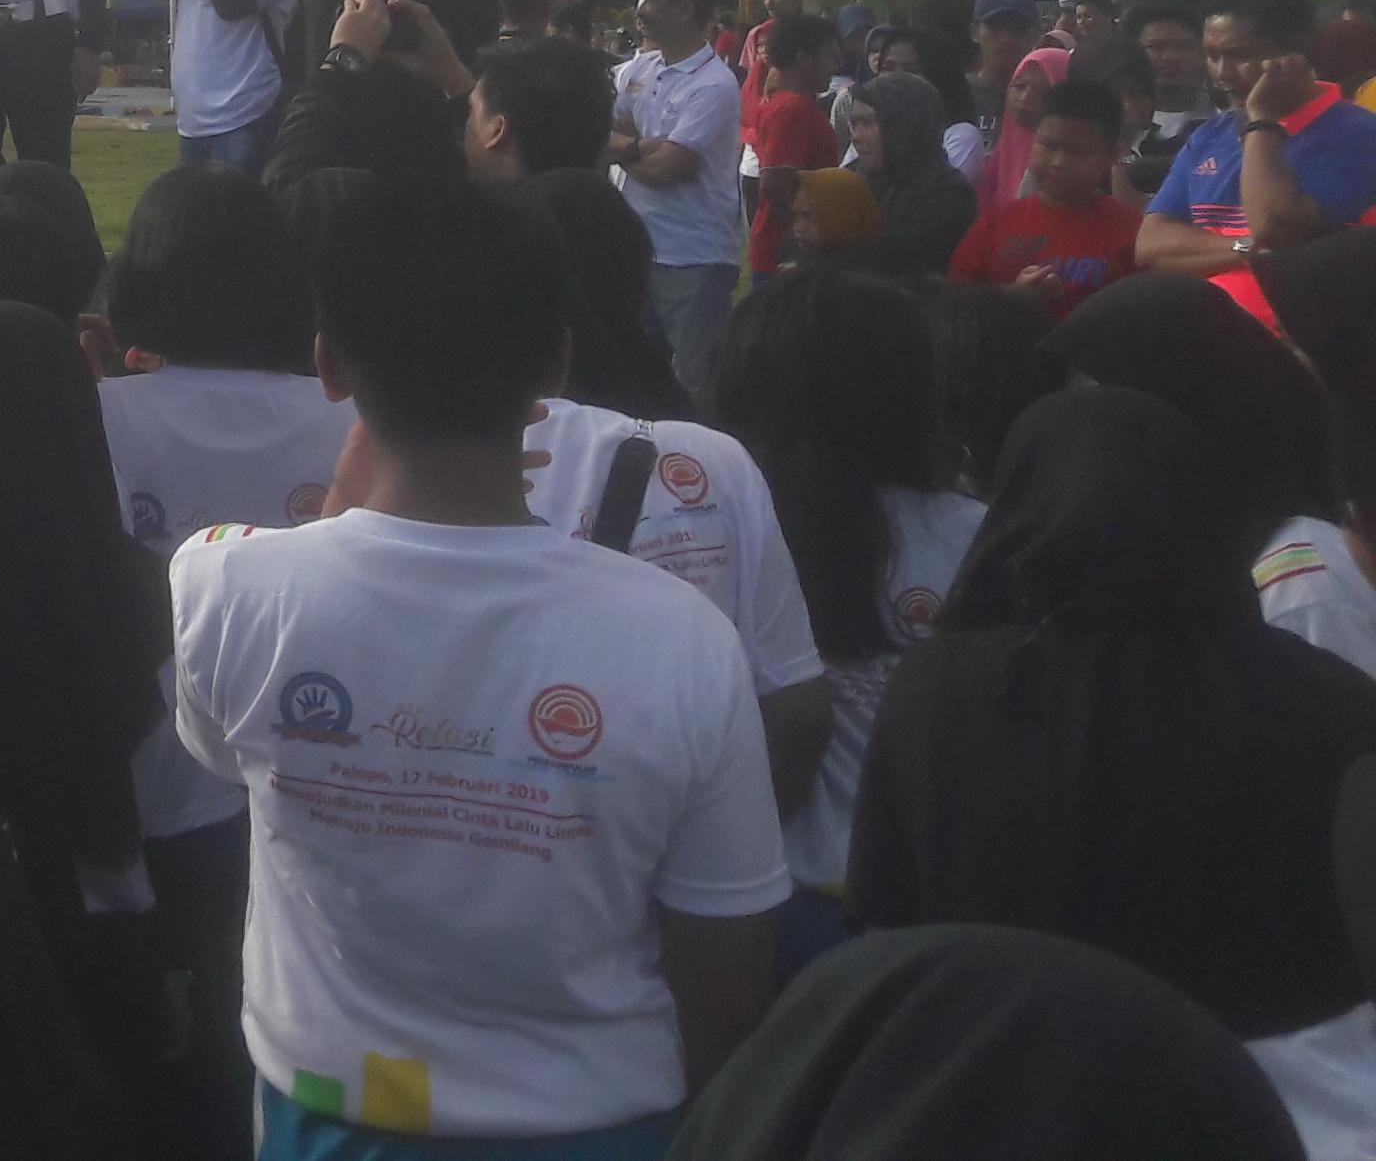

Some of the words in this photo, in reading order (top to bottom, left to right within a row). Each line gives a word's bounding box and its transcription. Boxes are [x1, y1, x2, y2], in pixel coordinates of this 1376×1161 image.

[402, 770, 421, 785] 17
[507, 782, 550, 804] 2019
[505, 816, 541, 836] Lalu
